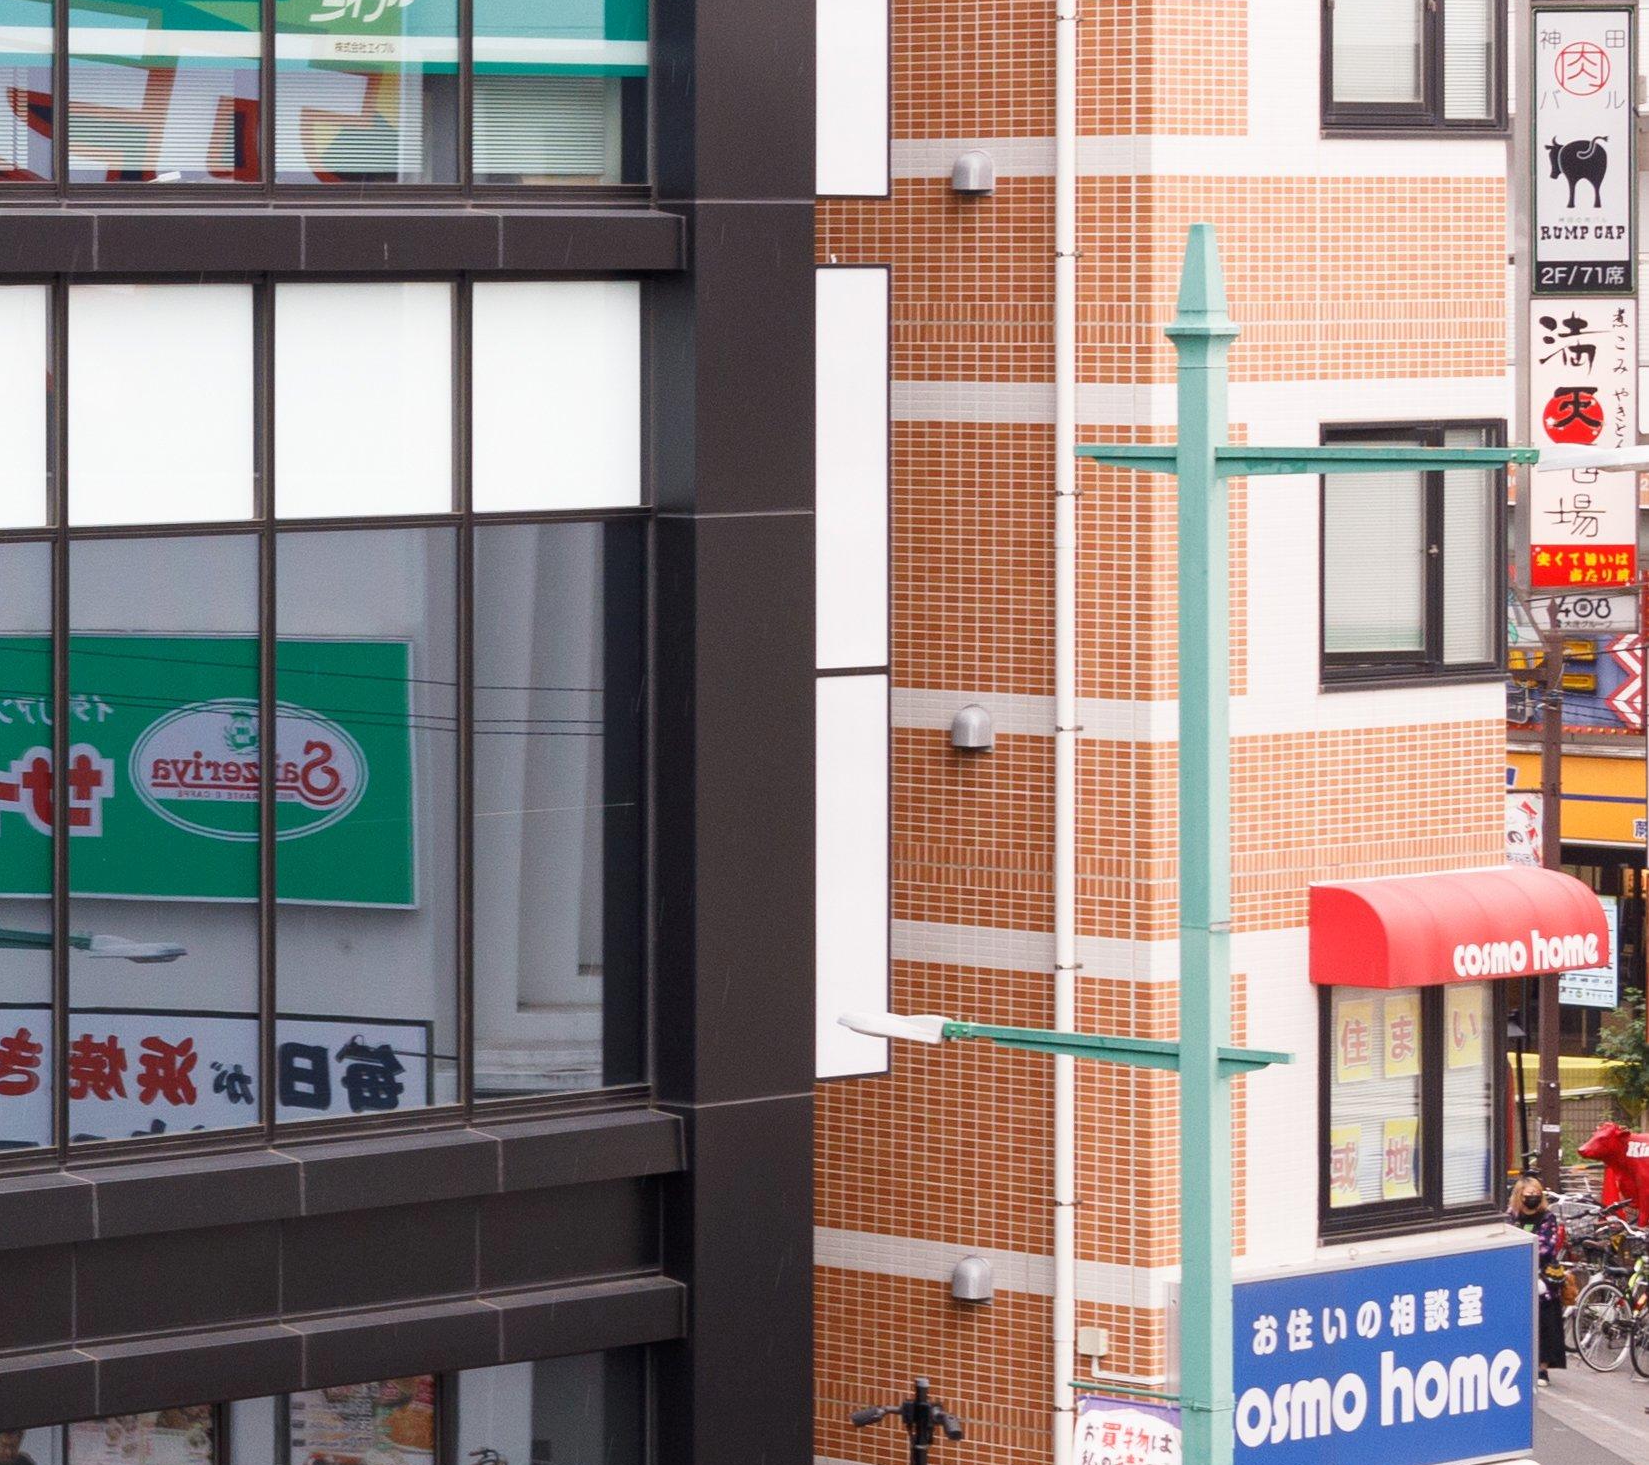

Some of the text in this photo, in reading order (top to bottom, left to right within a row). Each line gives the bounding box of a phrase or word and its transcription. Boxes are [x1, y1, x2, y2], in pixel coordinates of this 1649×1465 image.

[1540, 225, 1626, 240] RUMP CAP
[1454, 929, 1599, 979] cosmo home
[1252, 1284, 1485, 1356] お住いの相談室
[1234, 1347, 1523, 1450] osmo home
[1084, 1422, 1173, 1454] お買物は
